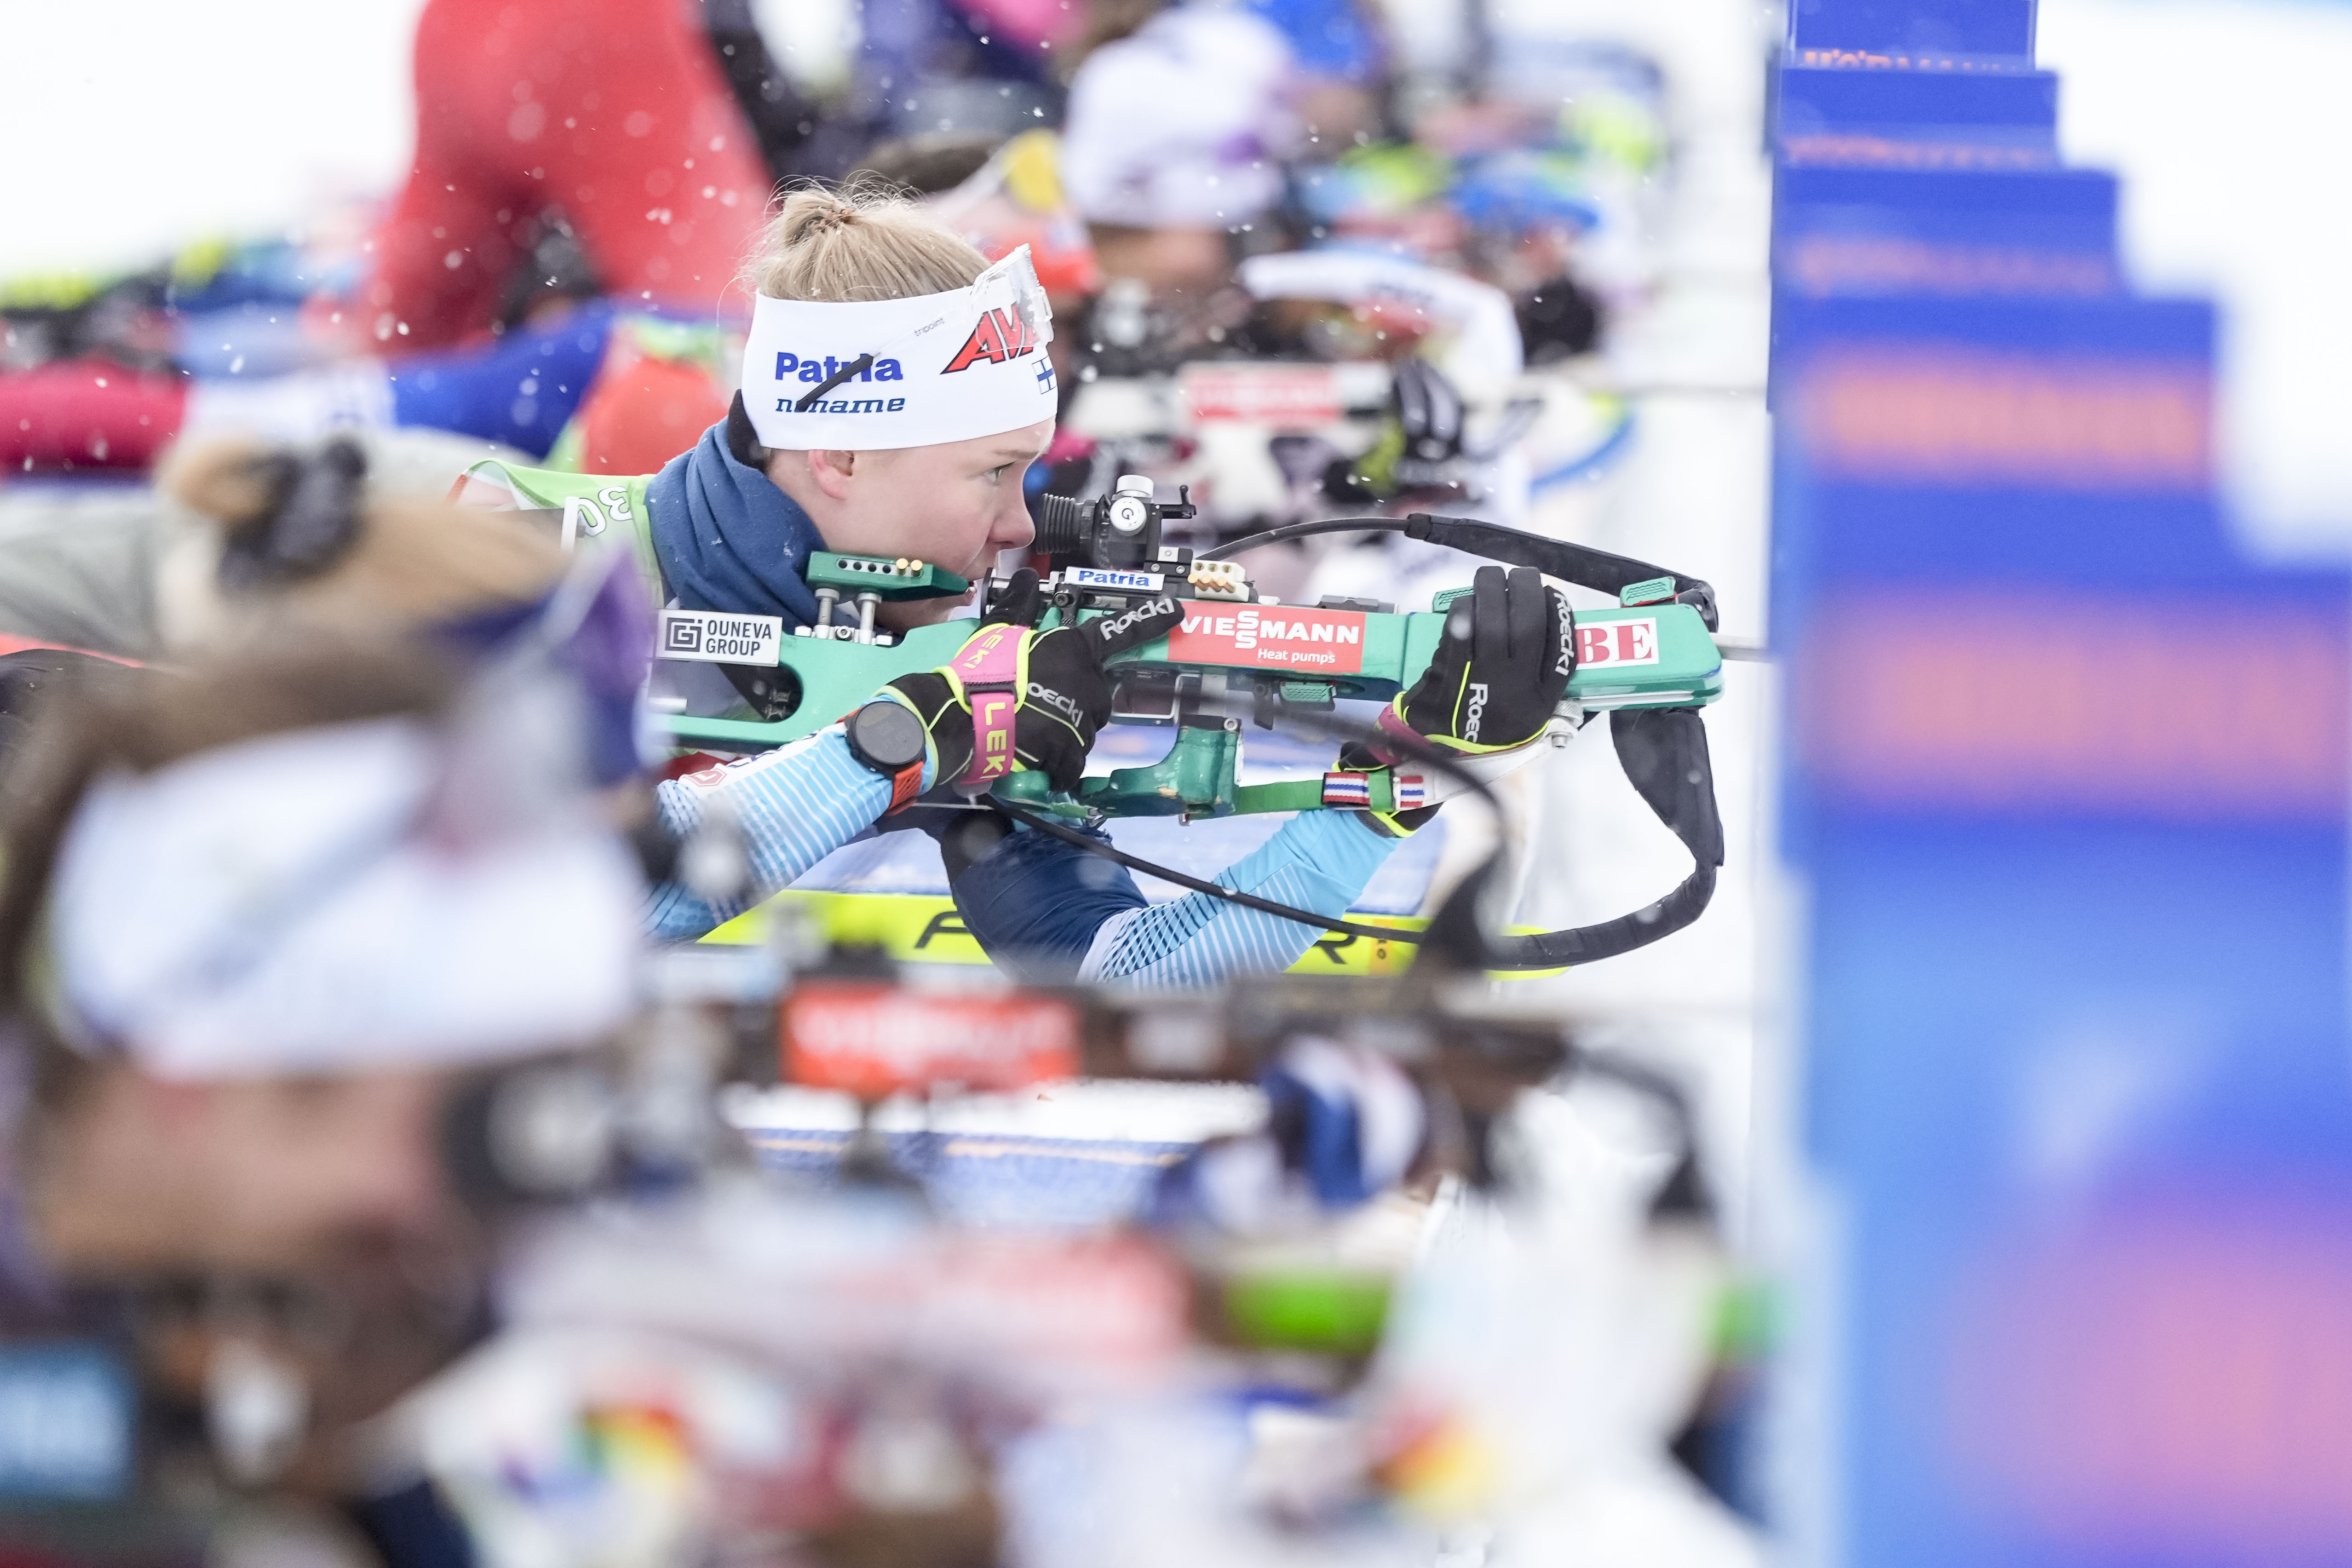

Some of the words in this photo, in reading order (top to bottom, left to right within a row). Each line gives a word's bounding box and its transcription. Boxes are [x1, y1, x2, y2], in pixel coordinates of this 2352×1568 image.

[775, 352, 903, 383] Patria
[776, 398, 905, 413] nname
[1078, 570, 1150, 587] Patria
[707, 620, 772, 639] OUNEVA
[706, 638, 760, 656] GROUP
[1257, 648, 1288, 661] Heat
[1291, 652, 1336, 666] pumps
[979, 702, 1007, 779] LEKI
